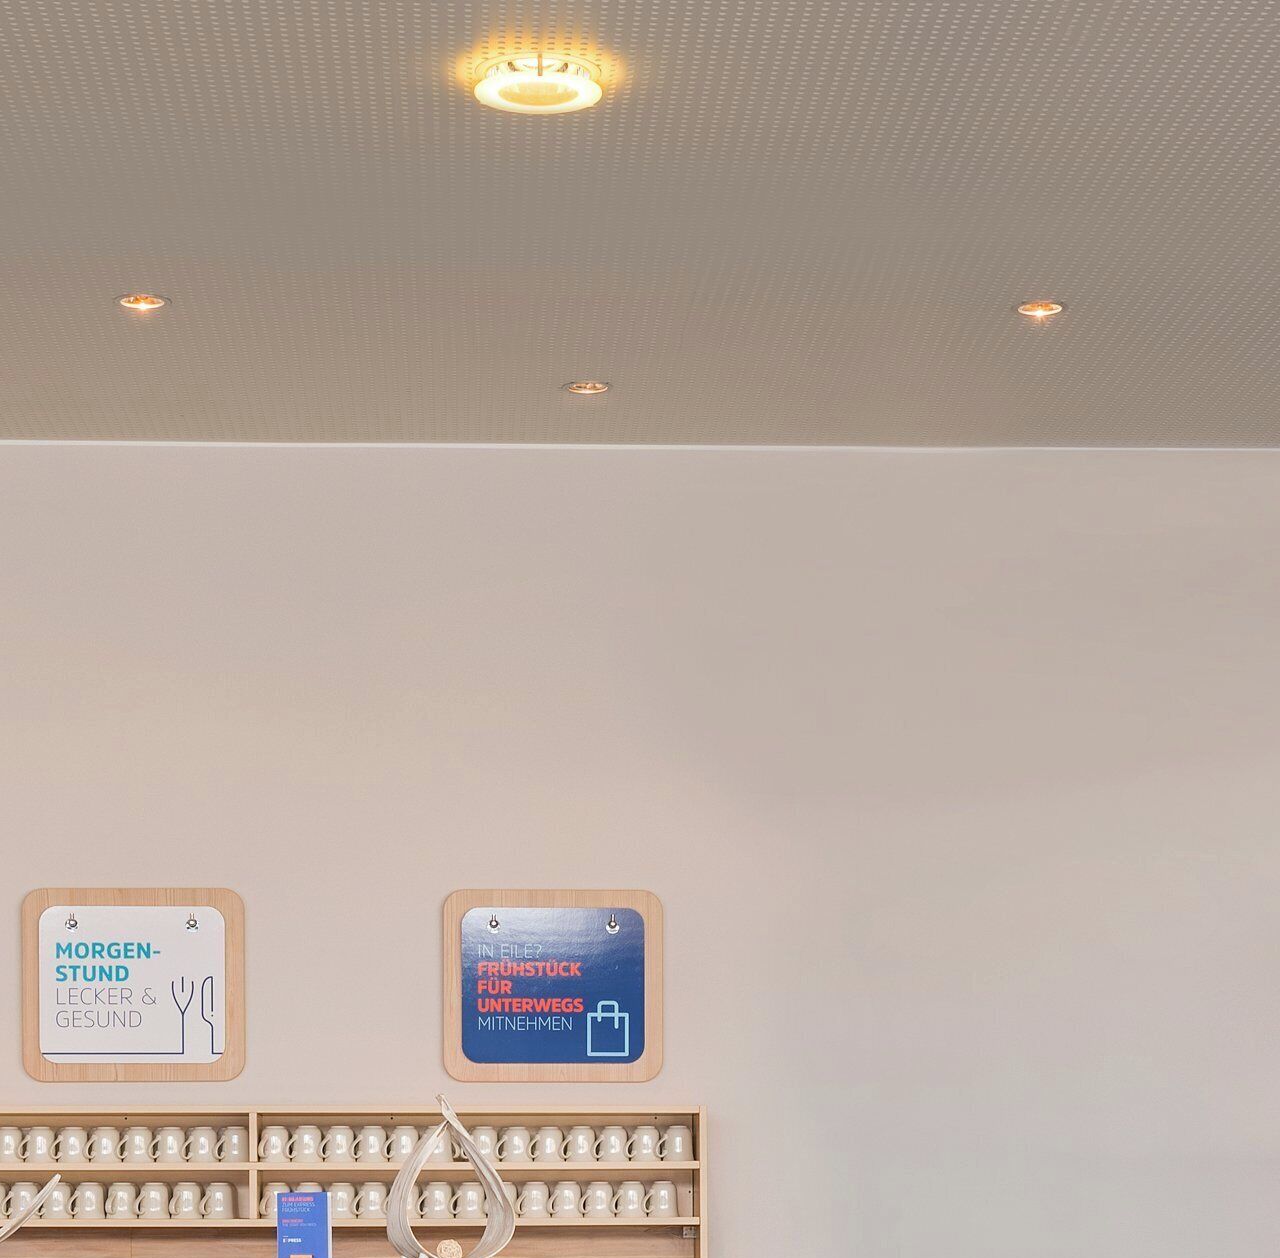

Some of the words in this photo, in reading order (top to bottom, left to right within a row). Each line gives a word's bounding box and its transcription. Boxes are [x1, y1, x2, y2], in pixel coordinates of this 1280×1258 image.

[55, 942, 161, 959] MORGEN-
[478, 944, 494, 958] IN
[500, 944, 542, 958] EILE?
[55, 965, 130, 982] STUND
[477, 959, 582, 977] FRÜHSTÜCK
[477, 977, 512, 994] FÜR
[56, 987, 133, 1005] LECKER
[141, 987, 157, 1005] &
[477, 998, 584, 1013] UNTERWEGS
[55, 1010, 142, 1028] GESUND
[478, 1017, 573, 1031] MITNEHMEN
